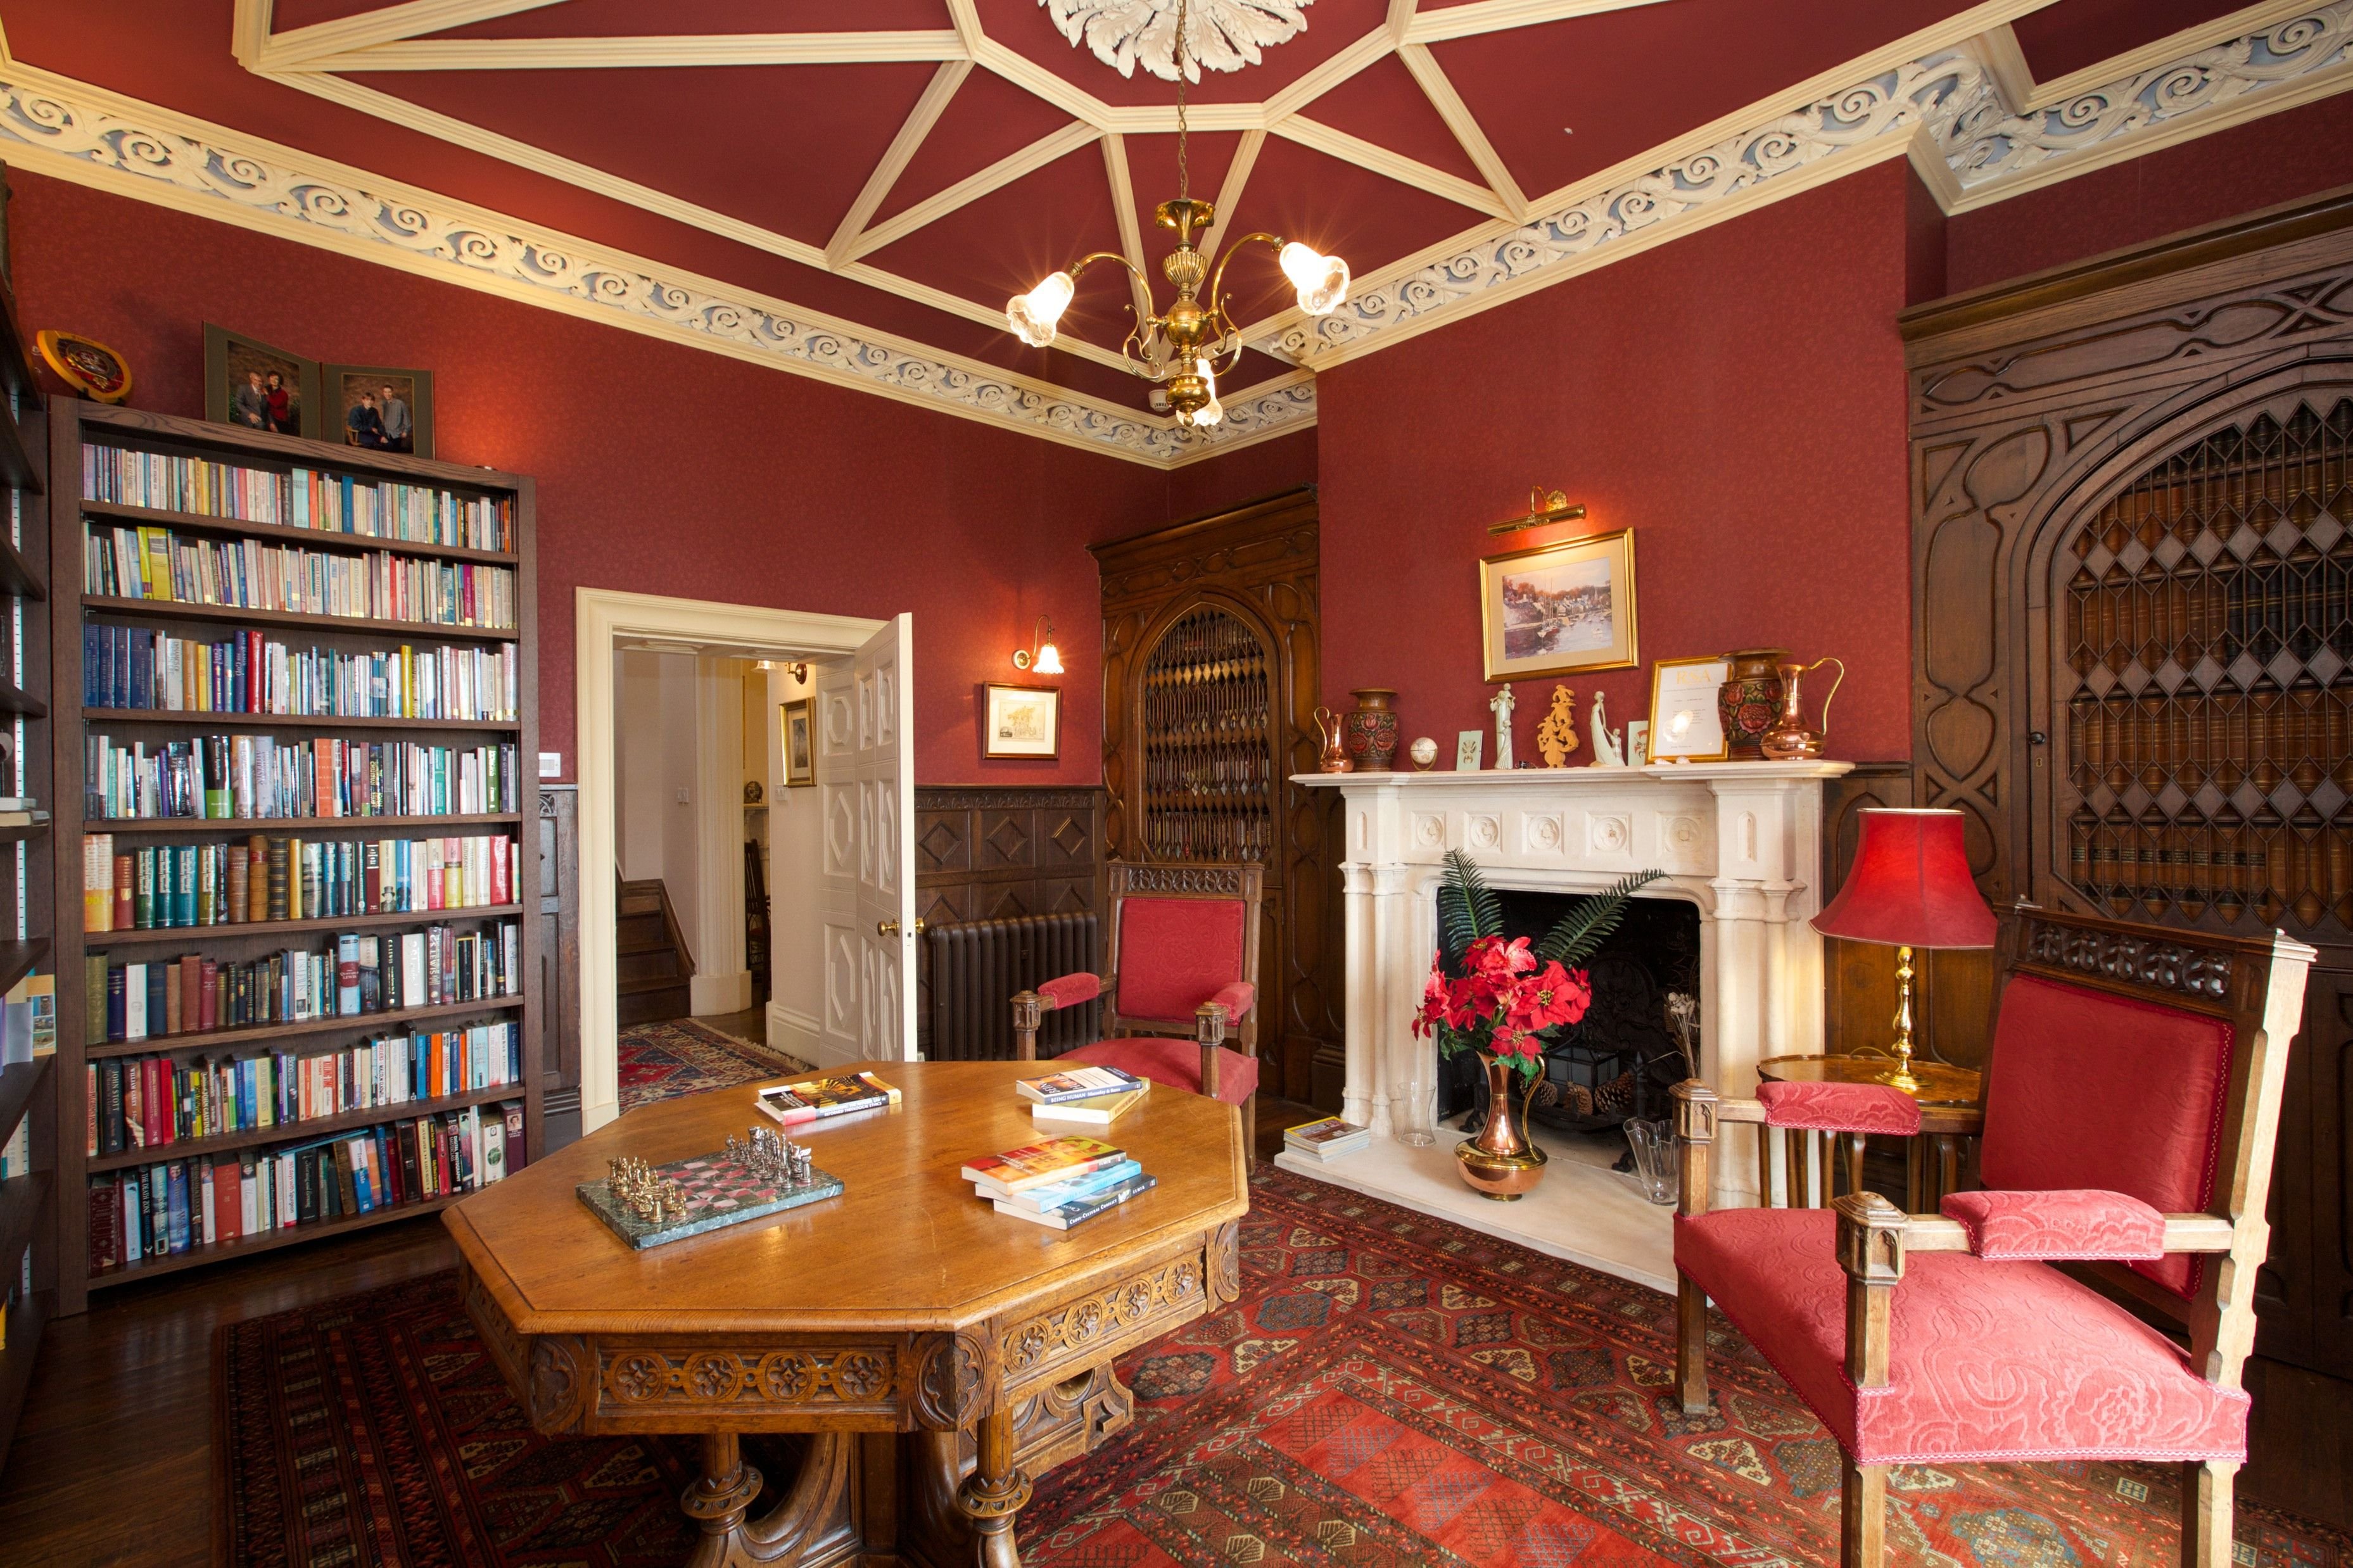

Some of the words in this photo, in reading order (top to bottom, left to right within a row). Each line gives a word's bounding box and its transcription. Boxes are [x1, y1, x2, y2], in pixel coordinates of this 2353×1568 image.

[1677, 669, 1711, 685] RSA
[323, 1061, 332, 1077] KILLING
[323, 1078, 333, 1089] TIME
[1067, 1092, 1086, 1101] HUMAN
[824, 1108, 844, 1116] REFORMED
[304, 1160, 312, 1182] Morning
[1132, 1185, 1145, 1194] ELMER
[177, 1211, 186, 1239] Walker
